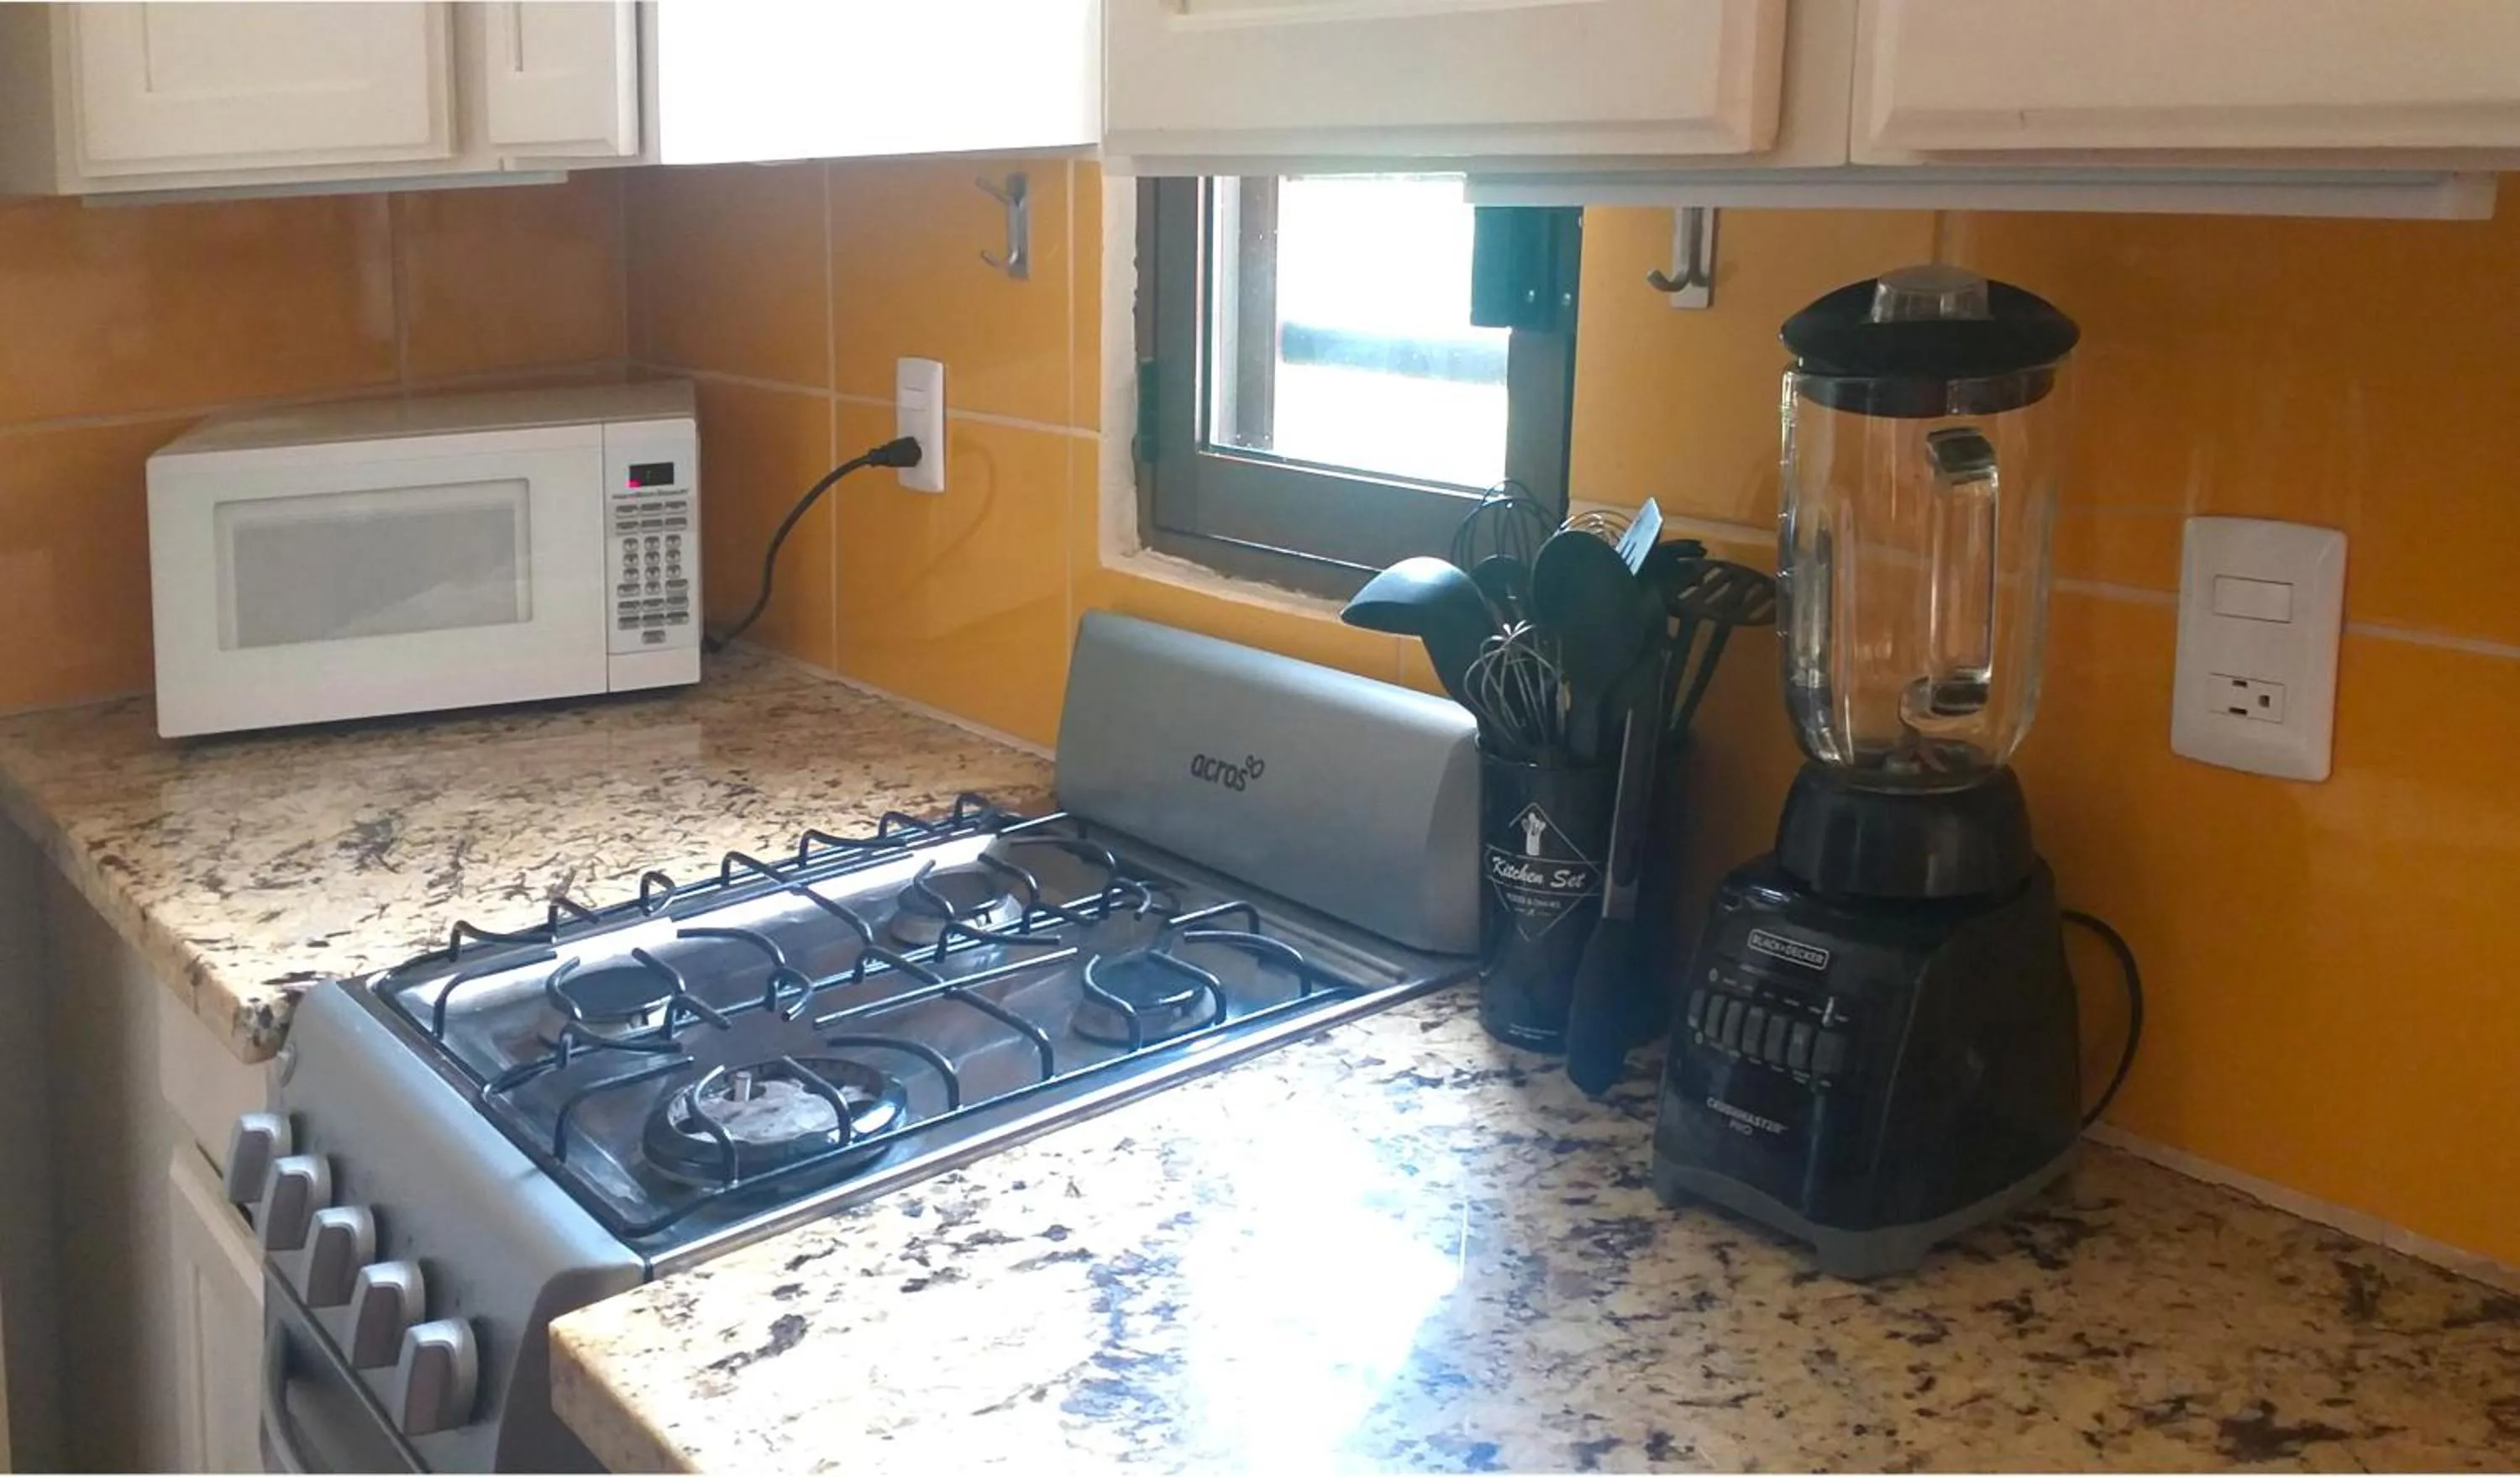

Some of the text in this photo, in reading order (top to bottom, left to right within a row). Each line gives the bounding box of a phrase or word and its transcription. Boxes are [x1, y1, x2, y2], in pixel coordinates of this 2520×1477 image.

[1190, 754, 1248, 791] acros
[1492, 855, 1586, 888] Kitchen Set
